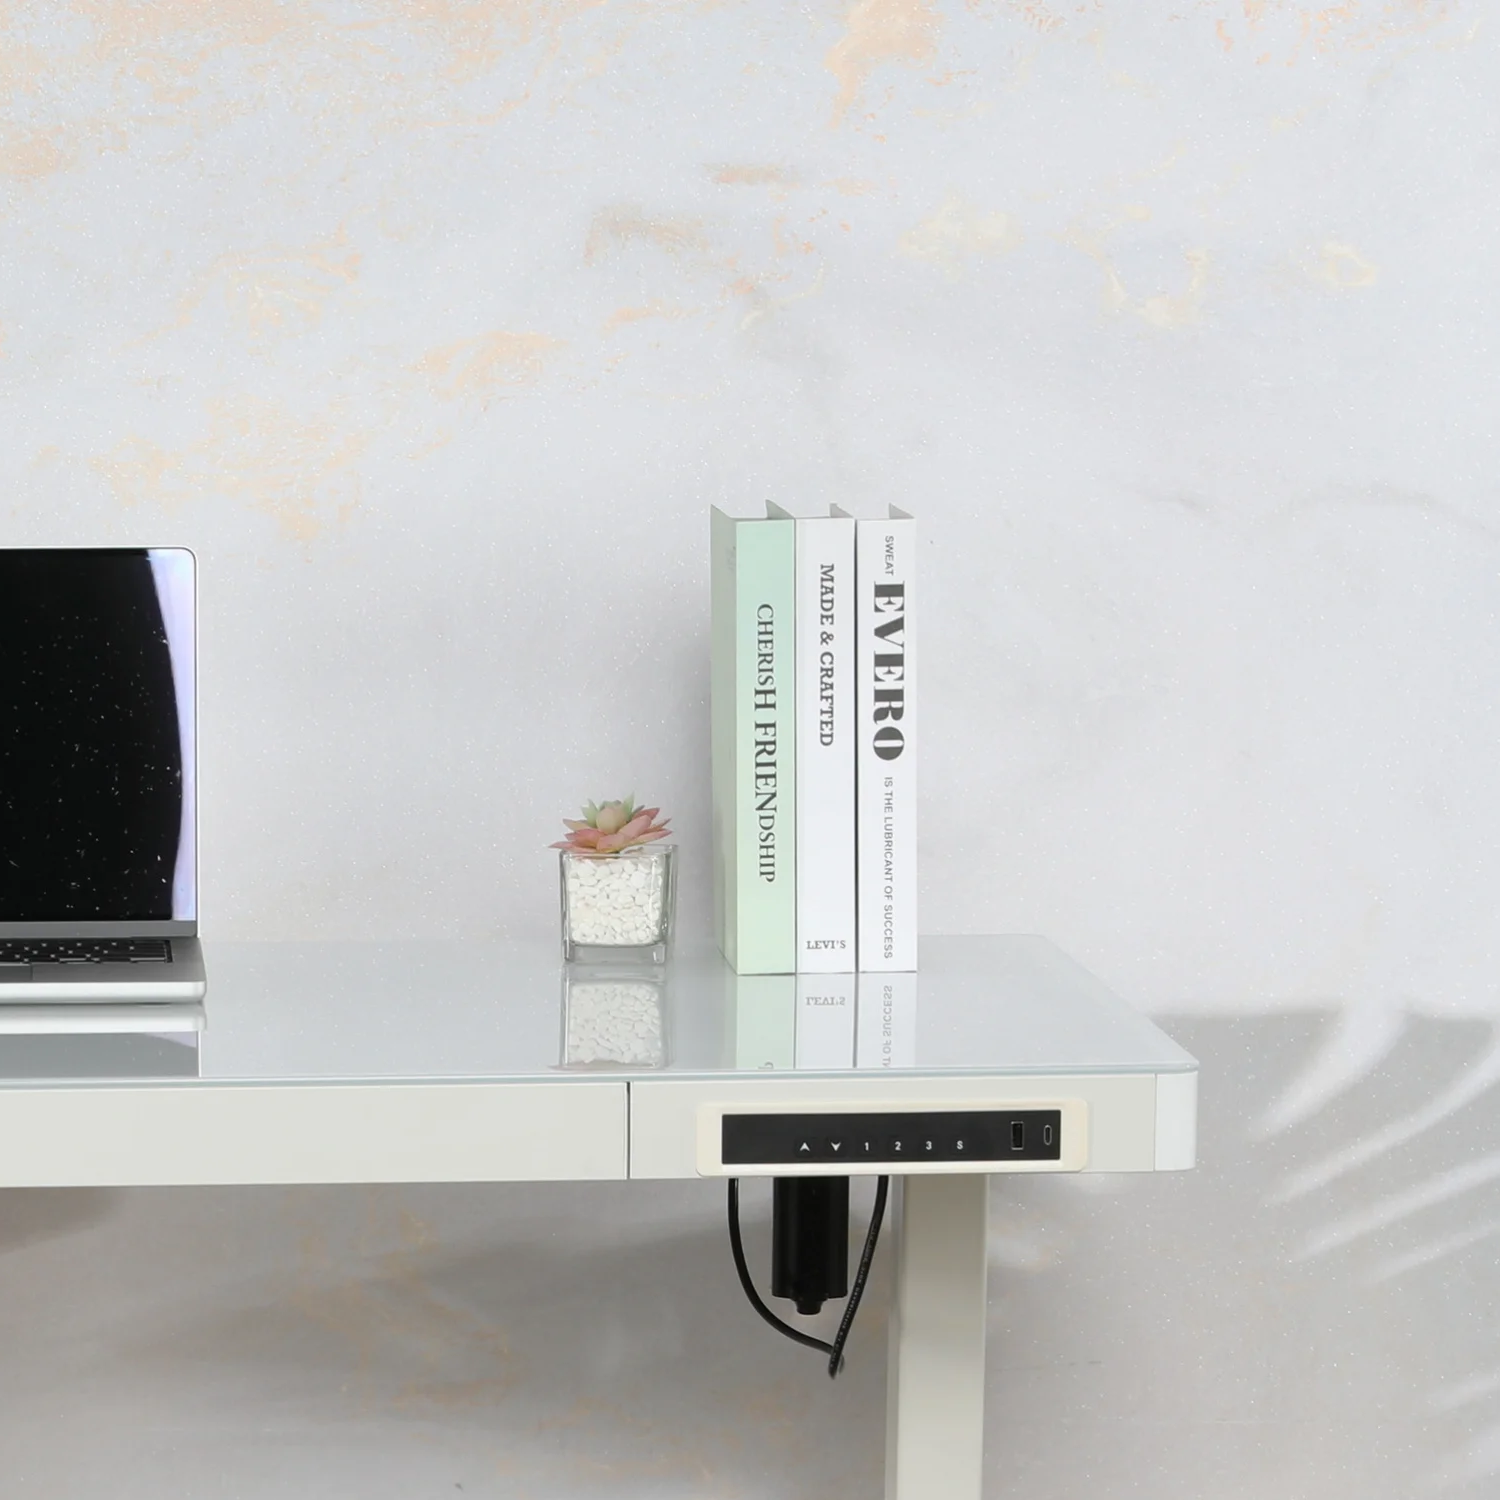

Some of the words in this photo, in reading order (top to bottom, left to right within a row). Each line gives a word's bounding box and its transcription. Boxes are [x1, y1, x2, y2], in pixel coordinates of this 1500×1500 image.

[884, 535, 895, 576] SWEAT
[819, 563, 835, 626] MADE
[754, 603, 777, 711] CHERISH
[819, 630, 835, 646] &
[872, 581, 905, 761] EVERO
[819, 651, 835, 747] CRAFTED
[754, 721, 778, 883] FRIENDSHIP
[883, 776, 894, 788] IS
[883, 790, 894, 813] THE
[883, 816, 894, 882] LUBRICANT
[883, 885, 894, 901] OF
[806, 939, 847, 950] LEVI'S
[883, 904, 894, 959] SUCCESS
[864, 1141, 870, 1151] 1
[894, 1140, 902, 1151] 2
[925, 1140, 933, 1151] 3
